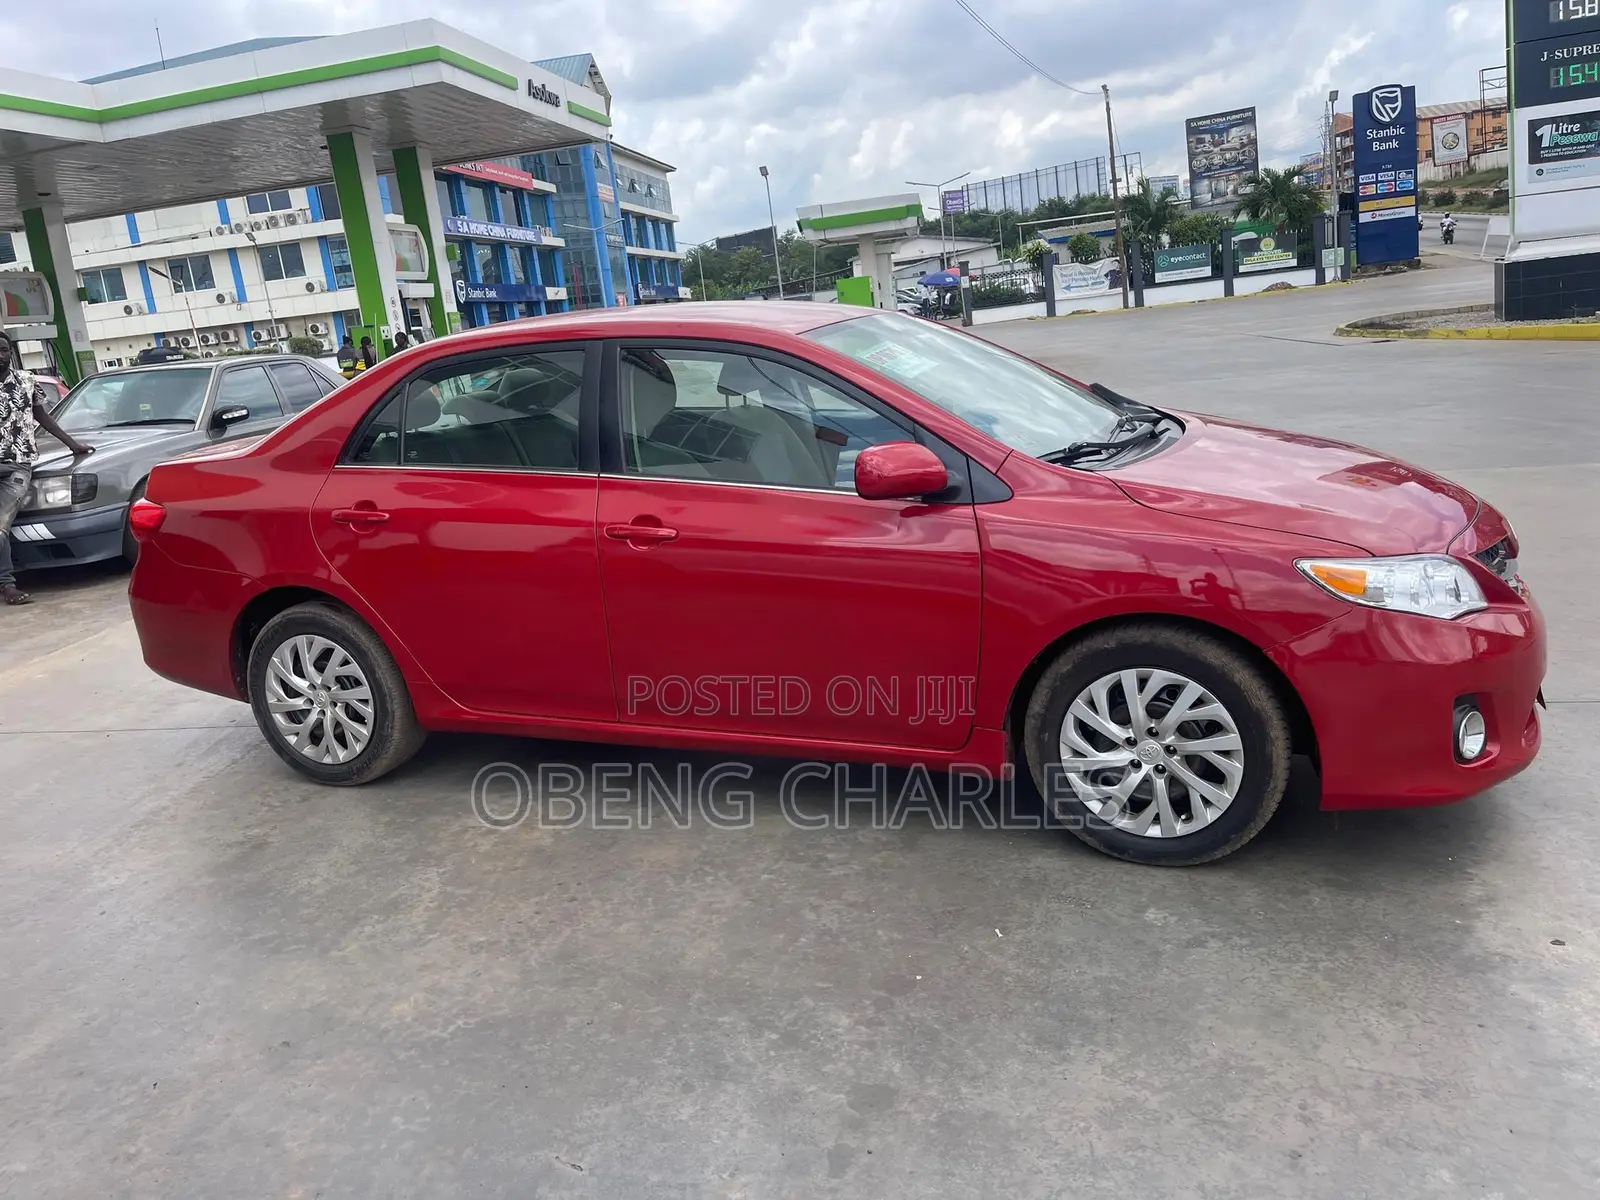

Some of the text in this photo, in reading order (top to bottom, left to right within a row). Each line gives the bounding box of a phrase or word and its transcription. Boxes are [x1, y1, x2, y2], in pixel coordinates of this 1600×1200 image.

[1541, 43, 1600, 61] J-SUPRE
[1560, 62, 1598, 86] 15.4
[1198, 119, 1211, 127] HOME
[1212, 116, 1226, 124] CHINA
[1227, 111, 1252, 121] FURNITURE
[1366, 125, 1406, 139] Stanbic
[1535, 123, 1580, 147] 1 Litre
[1550, 132, 1598, 146] Pesewa
[1373, 139, 1399, 151] Bank
[469, 222, 488, 237] HOME
[507, 227, 536, 241] FURNITURE
[1171, 252, 1206, 263] eyecontact
[1253, 249, 1281, 257] APPROVED
[468, 287, 498, 298] Stanbic Bank
